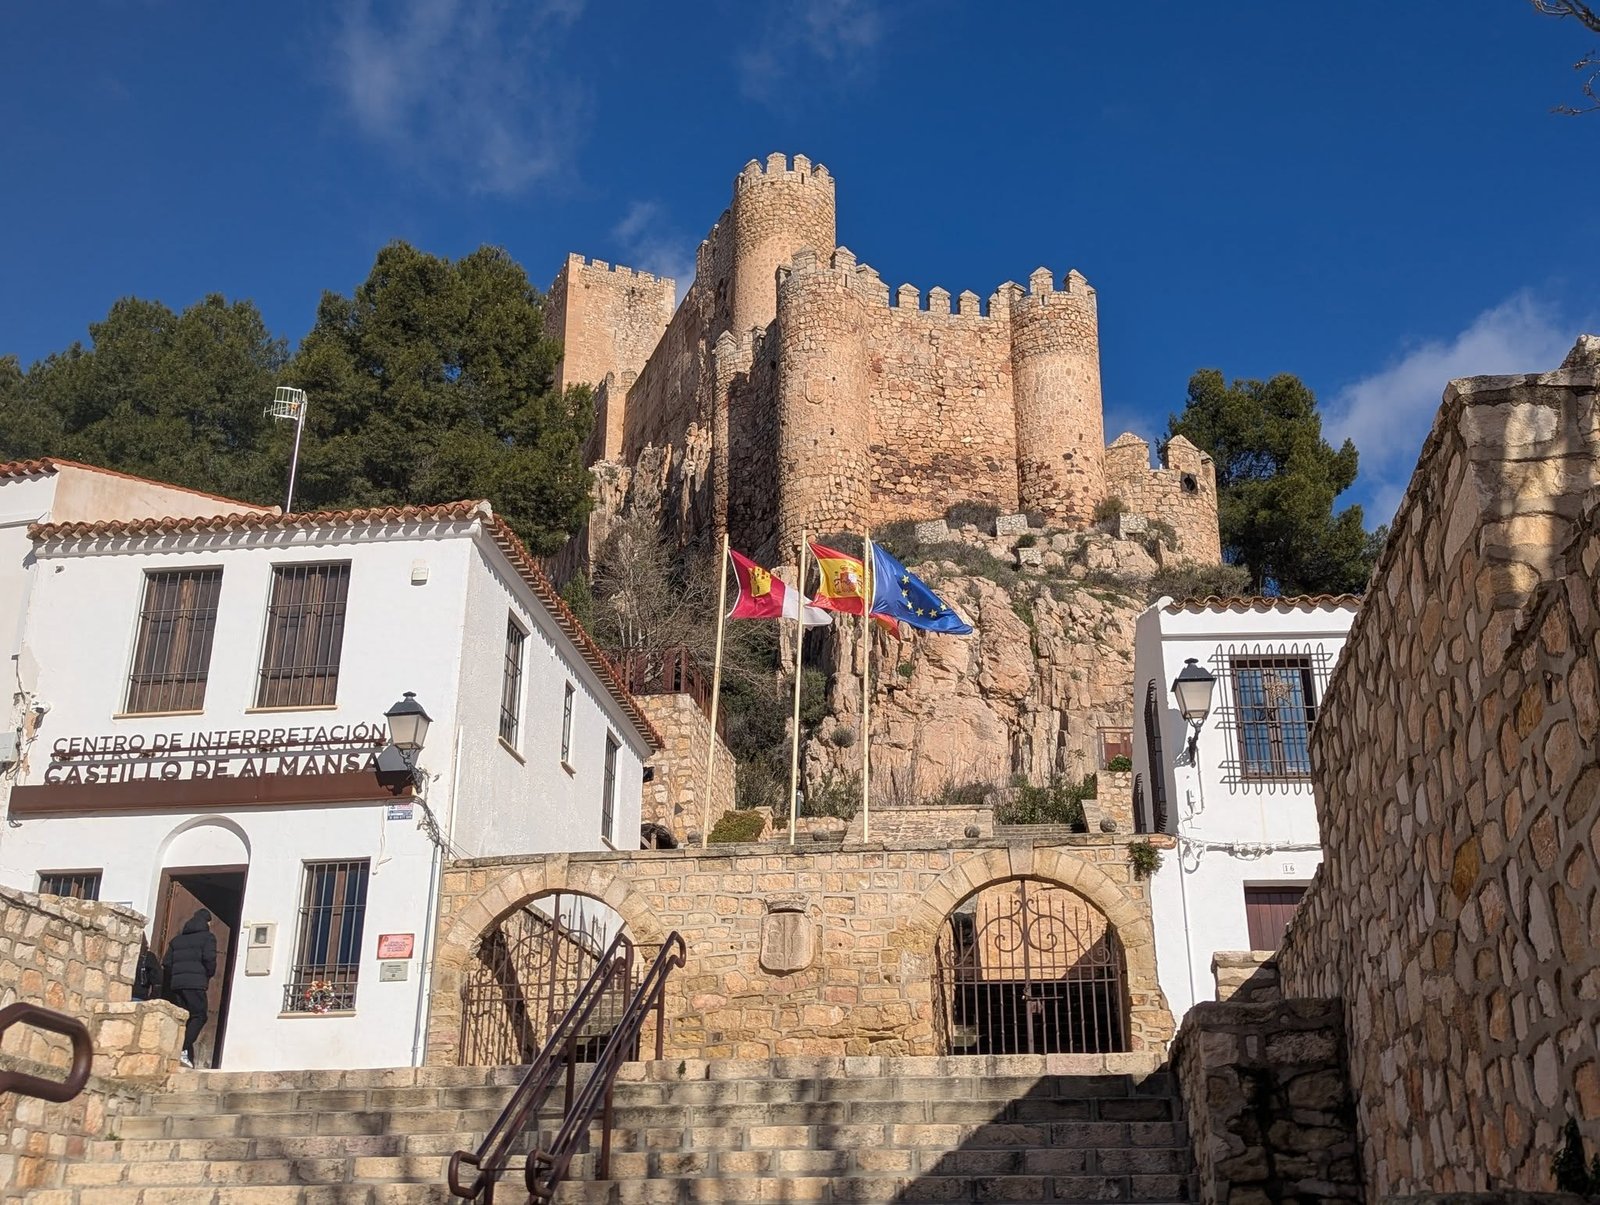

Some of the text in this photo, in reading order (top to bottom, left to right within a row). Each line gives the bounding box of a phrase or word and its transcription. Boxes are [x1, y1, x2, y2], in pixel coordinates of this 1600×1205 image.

[53, 721, 386, 754] CENTRO DE INTERPRETACIÓN
[44, 752, 378, 785] CASTILLO DE ALMANSA
